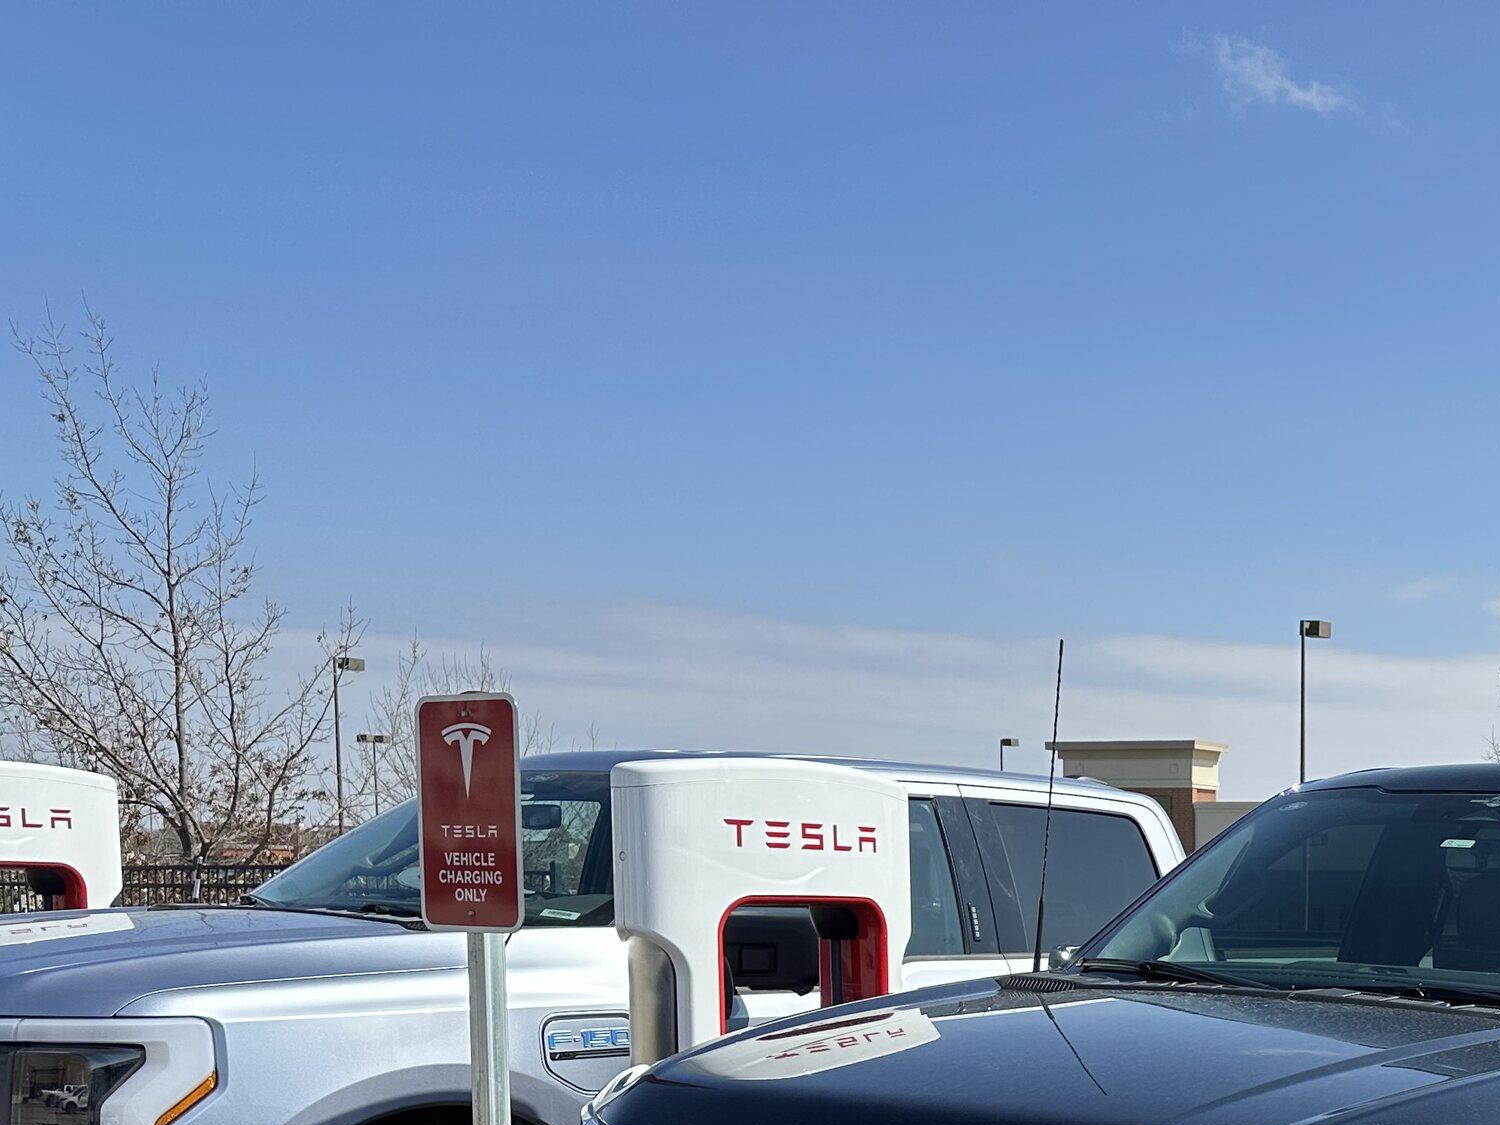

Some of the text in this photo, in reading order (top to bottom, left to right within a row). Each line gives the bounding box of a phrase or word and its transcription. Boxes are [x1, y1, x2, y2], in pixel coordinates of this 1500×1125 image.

[440, 824, 498, 838] TESLA
[723, 818, 877, 853] TESLA
[444, 852, 496, 867] VEHICLE
[438, 869, 503, 885] CHARGING
[454, 887, 487, 902] ONLY
